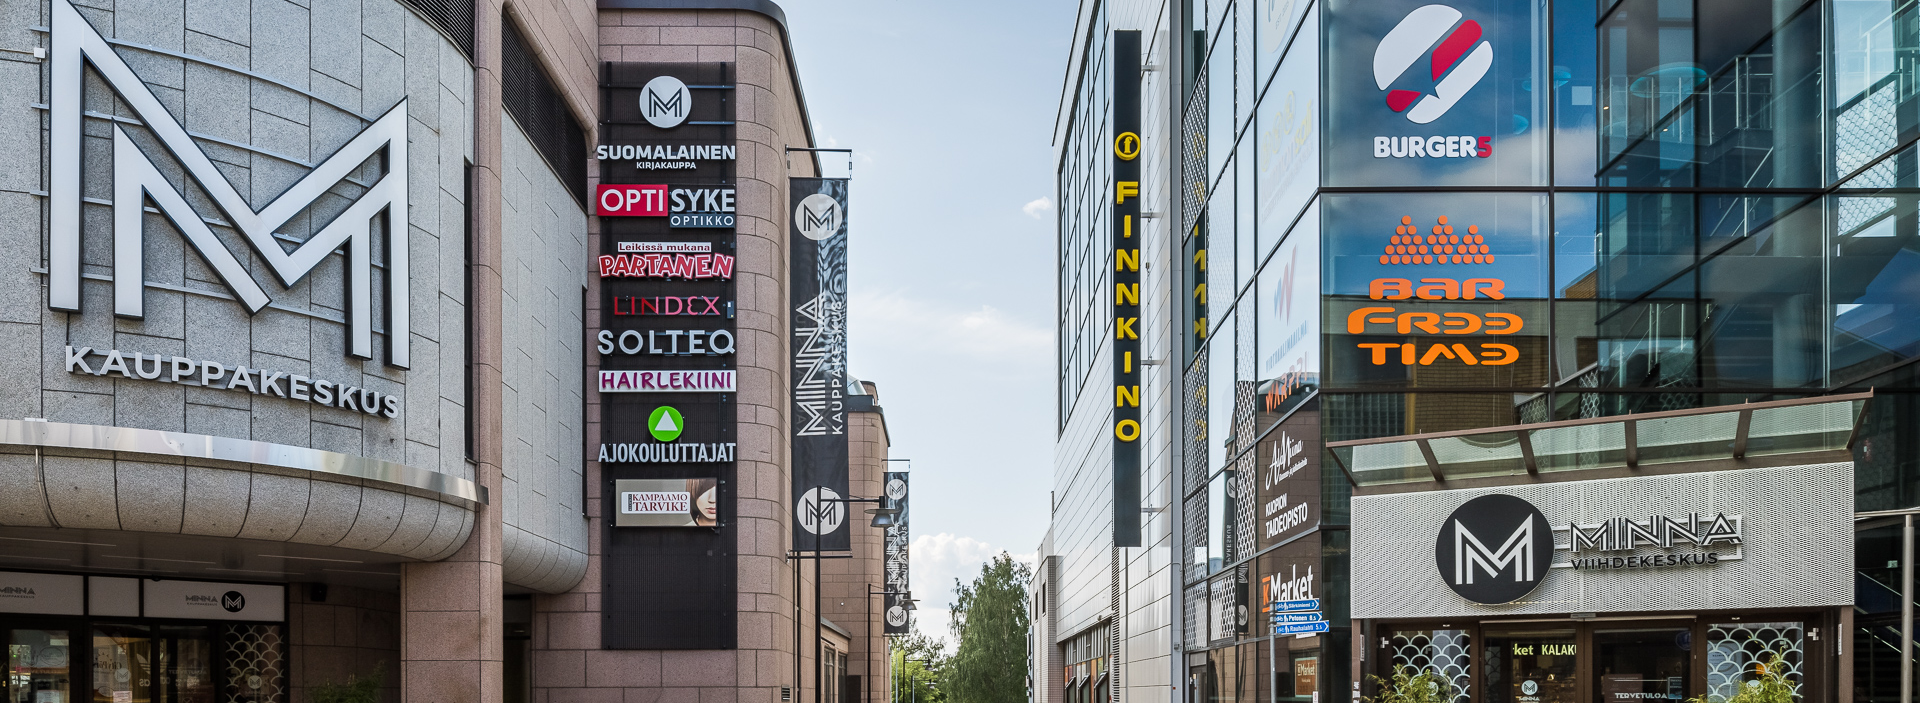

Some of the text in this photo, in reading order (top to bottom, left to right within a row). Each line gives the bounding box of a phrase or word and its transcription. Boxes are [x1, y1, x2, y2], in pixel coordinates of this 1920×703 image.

[597, 145, 735, 160] SUOMALAINEN
[1373, 136, 1493, 158] BURGER5
[636, 161, 697, 170] KIRJAKAUPPA
[601, 188, 735, 212] OPTI SYKE
[671, 215, 734, 227] OPTIKKO
[619, 242, 665, 252] Leikissä
[598, 252, 735, 279] PARTANEN
[613, 296, 721, 316] LINDEX
[1115, 181, 1141, 442] FINNKINO
[597, 329, 735, 355] SOLTEQ
[795, 292, 826, 436] MINNA
[831, 300, 843, 435] KAUPPAKESKUS
[64, 345, 400, 419] KAUPPAKESKUS
[601, 371, 732, 390] HAIRLEKIINI
[598, 442, 736, 463] AJOKOULUTTAJAT
[632, 493, 688, 501] KAMPAAMO
[632, 501, 688, 512] TARVIKE
[1265, 493, 1288, 518] KUOPION
[1265, 502, 1308, 539] TAIDEOPISTO
[1570, 510, 1743, 553] MINNA
[886, 521, 900, 585] MINNA
[1570, 551, 1719, 571] VIIHDEKESKUS
[1270, 563, 1314, 600] Market
[185, 594, 218, 602] MINNA
[1512, 643, 1534, 656] ket
